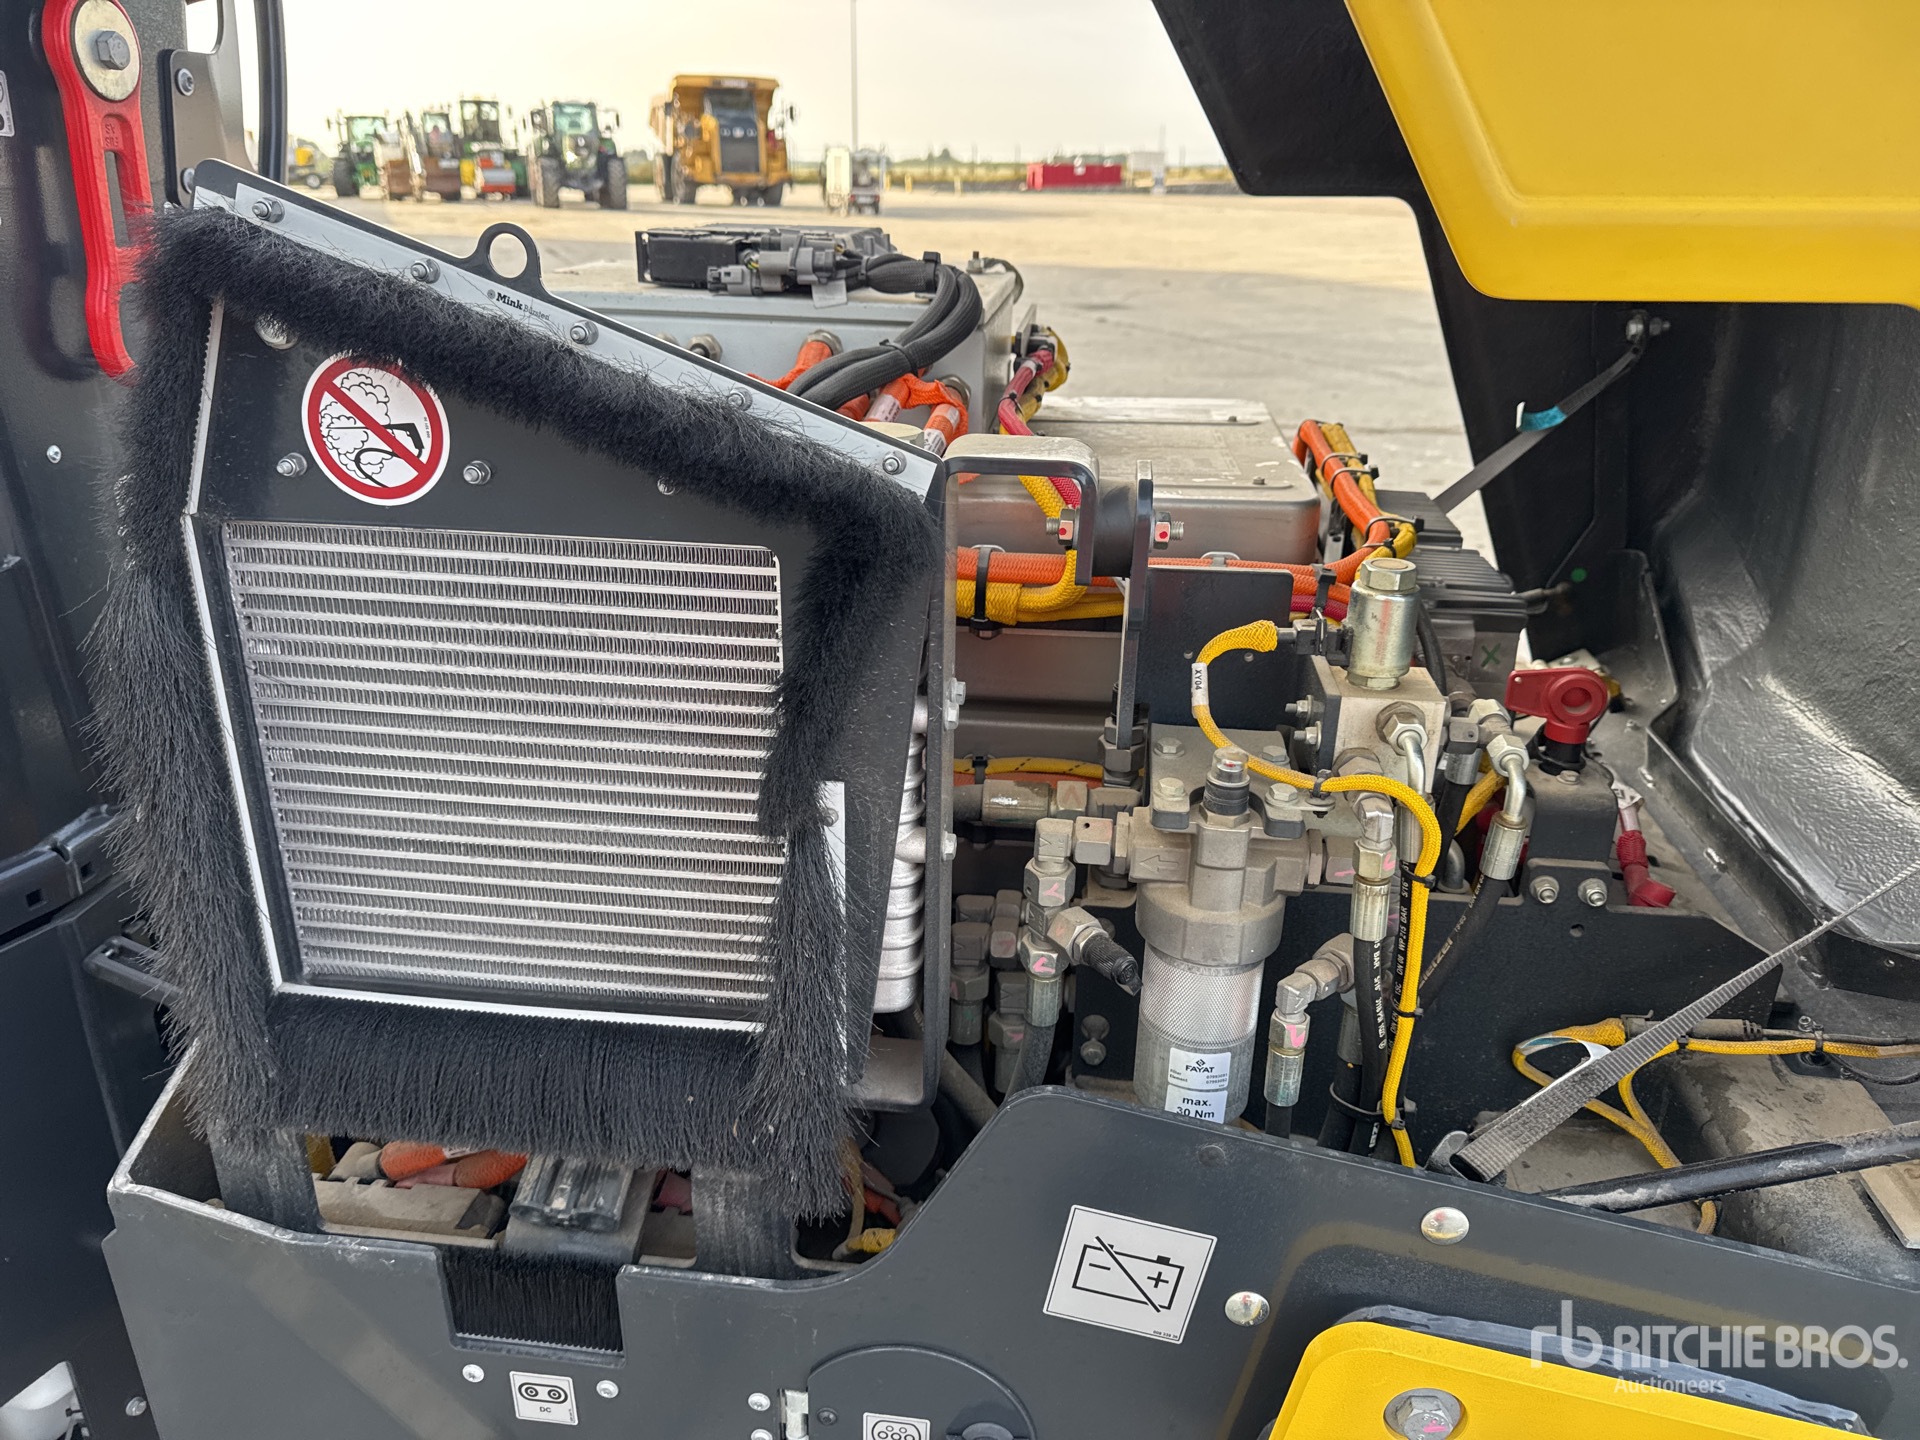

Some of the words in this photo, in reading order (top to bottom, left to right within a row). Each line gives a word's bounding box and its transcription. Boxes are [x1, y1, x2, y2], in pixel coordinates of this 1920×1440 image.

[496, 292, 523, 310] Mink
[1194, 669, 1203, 690] XY04
[1400, 905, 1408, 924] BAR
[1373, 950, 1381, 970] BAR
[1185, 1064, 1215, 1074] FAYAT
[1182, 1097, 1212, 1107] max.
[1176, 1106, 1191, 1117] 30
[1194, 1109, 1215, 1119] Nm
